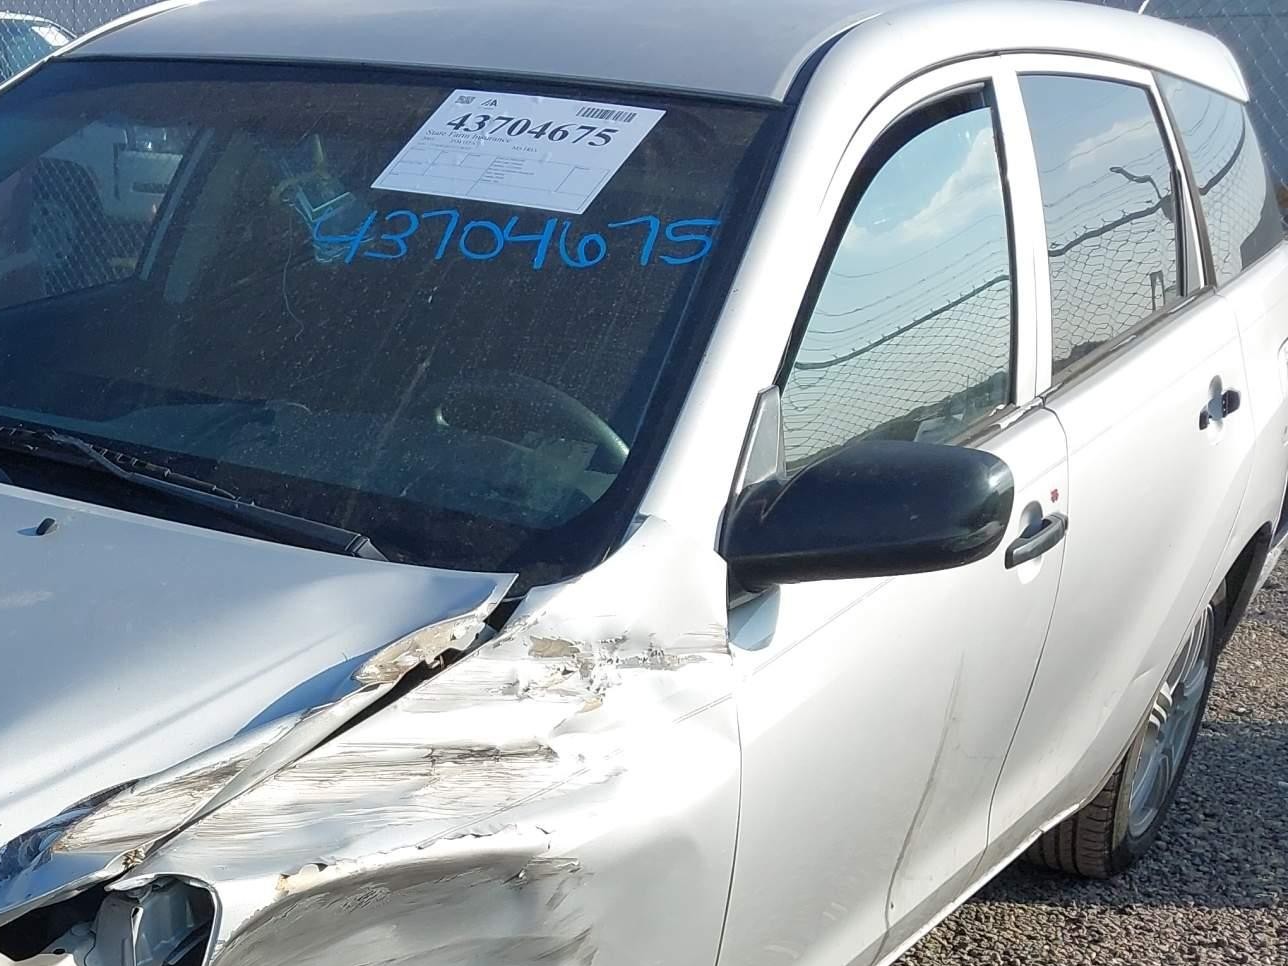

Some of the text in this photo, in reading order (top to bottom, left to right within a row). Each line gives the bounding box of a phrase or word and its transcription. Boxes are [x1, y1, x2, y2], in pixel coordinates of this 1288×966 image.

[447, 112, 619, 147] 43704675
[472, 132, 512, 144] Insurance
[313, 208, 722, 270] 43704675
